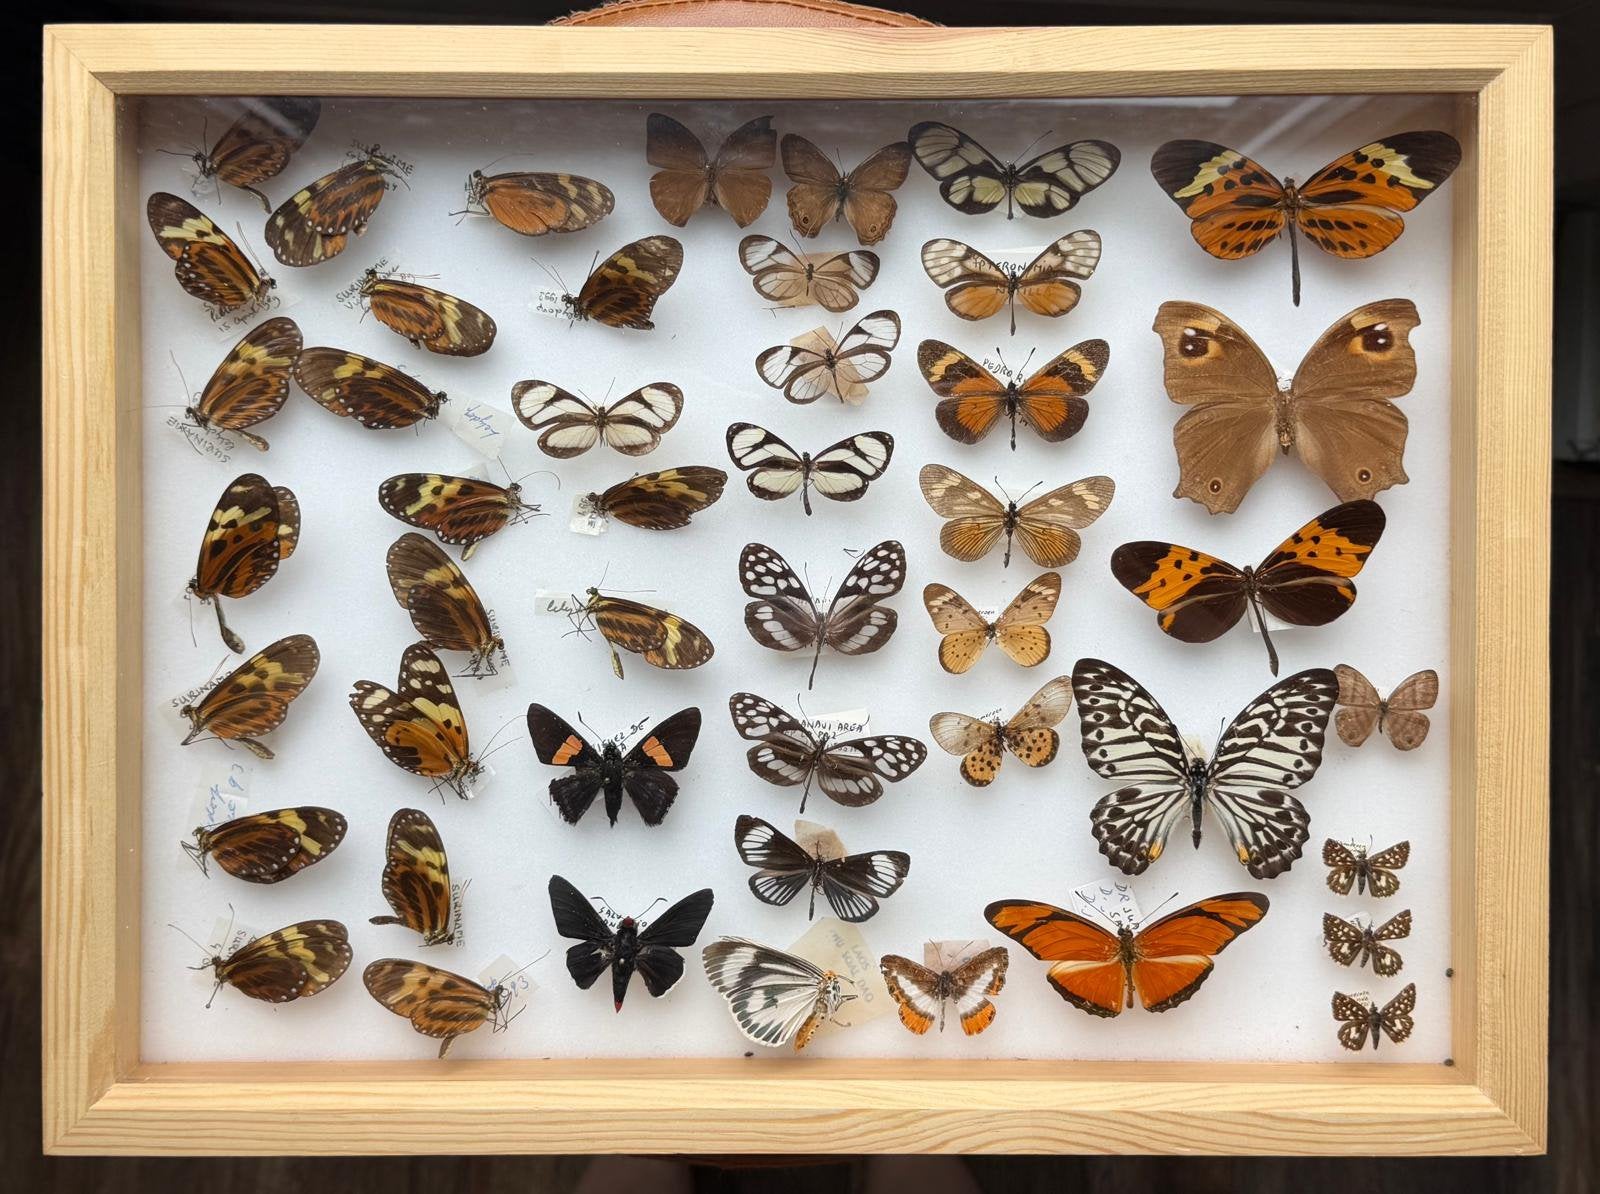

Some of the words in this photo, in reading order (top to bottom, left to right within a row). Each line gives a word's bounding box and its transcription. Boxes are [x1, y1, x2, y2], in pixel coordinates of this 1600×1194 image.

[335, 259, 388, 303] SURINME
[983, 358, 1013, 378] PEDRO
[838, 722, 864, 733] AREA
[452, 884, 466, 948] SURINAME
